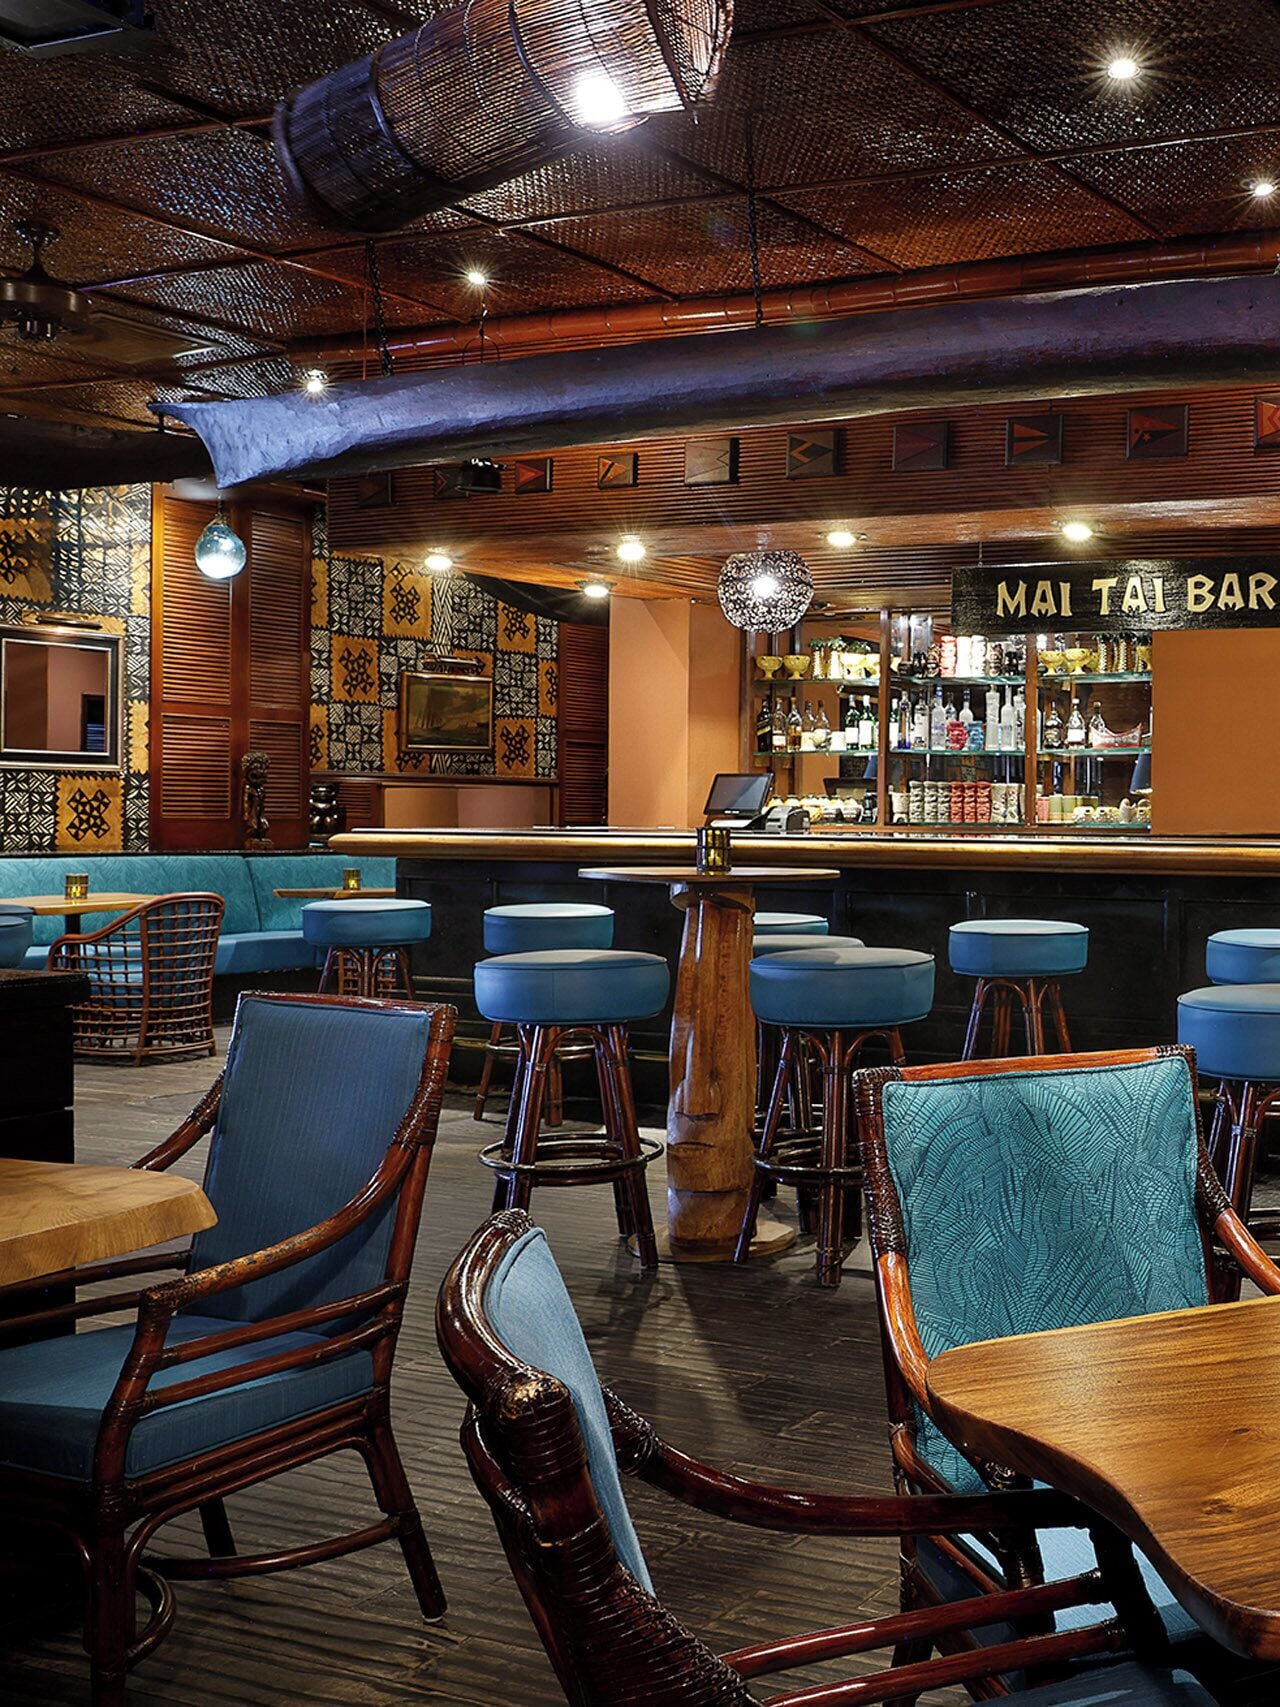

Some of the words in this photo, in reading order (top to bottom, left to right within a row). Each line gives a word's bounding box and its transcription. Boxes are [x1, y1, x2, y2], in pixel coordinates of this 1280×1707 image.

[997, 579, 1073, 617] MAI
[1092, 575, 1165, 616] TAI
[1187, 571, 1278, 613] BAR
